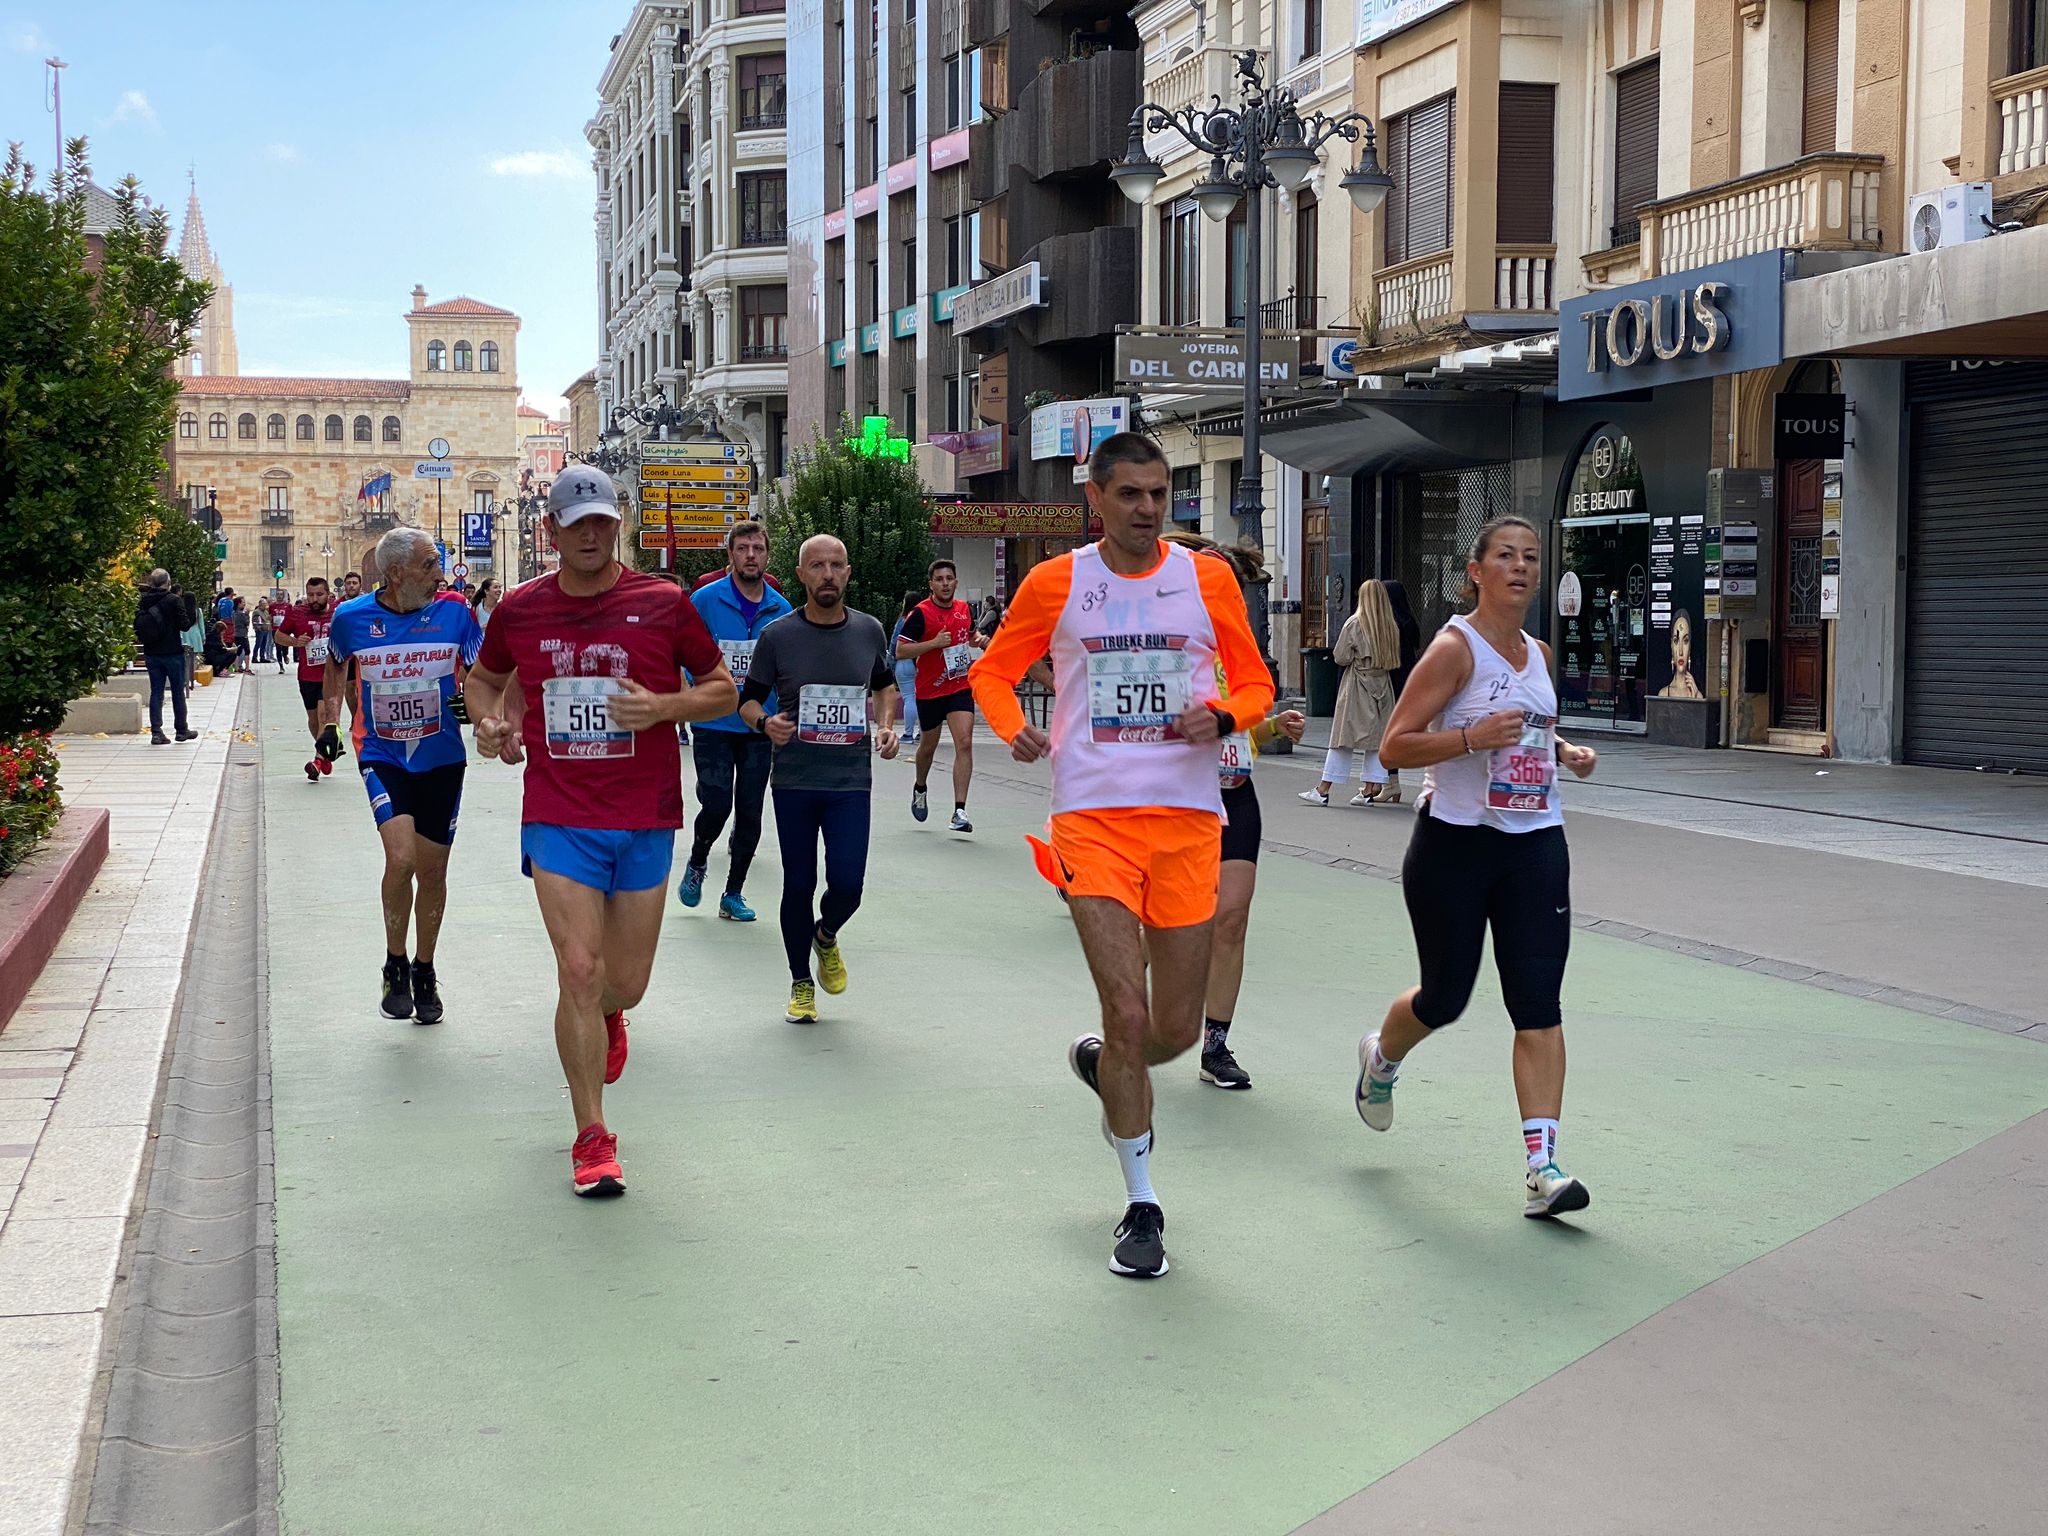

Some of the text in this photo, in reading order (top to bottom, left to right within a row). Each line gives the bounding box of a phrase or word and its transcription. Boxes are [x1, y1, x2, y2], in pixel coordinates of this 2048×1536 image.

[1578, 281, 1731, 373] TOUS
[1180, 343, 1239, 355] JOYERIA
[1129, 359, 1174, 377] DEL
[1781, 418, 1839, 434] TOUS
[1595, 447, 1610, 467] BE
[644, 468, 691, 477] Conde Luna
[676, 492, 696, 500] León
[1173, 487, 1200, 501] ESTRELLA
[1573, 488, 1634, 512] BE BEAUTY
[644, 513, 661, 521] A.C.
[683, 514, 714, 522] Antonio
[933, 504, 998, 517] ROYAL
[467, 514, 481, 537] P
[1629, 576, 1644, 594] BE
[1081, 582, 1109, 612] 33
[1145, 634, 1168, 648] RUN
[311, 646, 327, 657] 575
[385, 653, 401, 665] DE
[404, 648, 454, 664] ASTURIAS
[731, 655, 753, 670] 56
[954, 653, 968, 668] 585
[381, 664, 424, 679] LEÓN
[1116, 683, 1167, 714] 576
[388, 698, 425, 722] 305
[569, 704, 607, 731] 515
[816, 704, 850, 725] 530
[1509, 755, 1543, 784] 366
